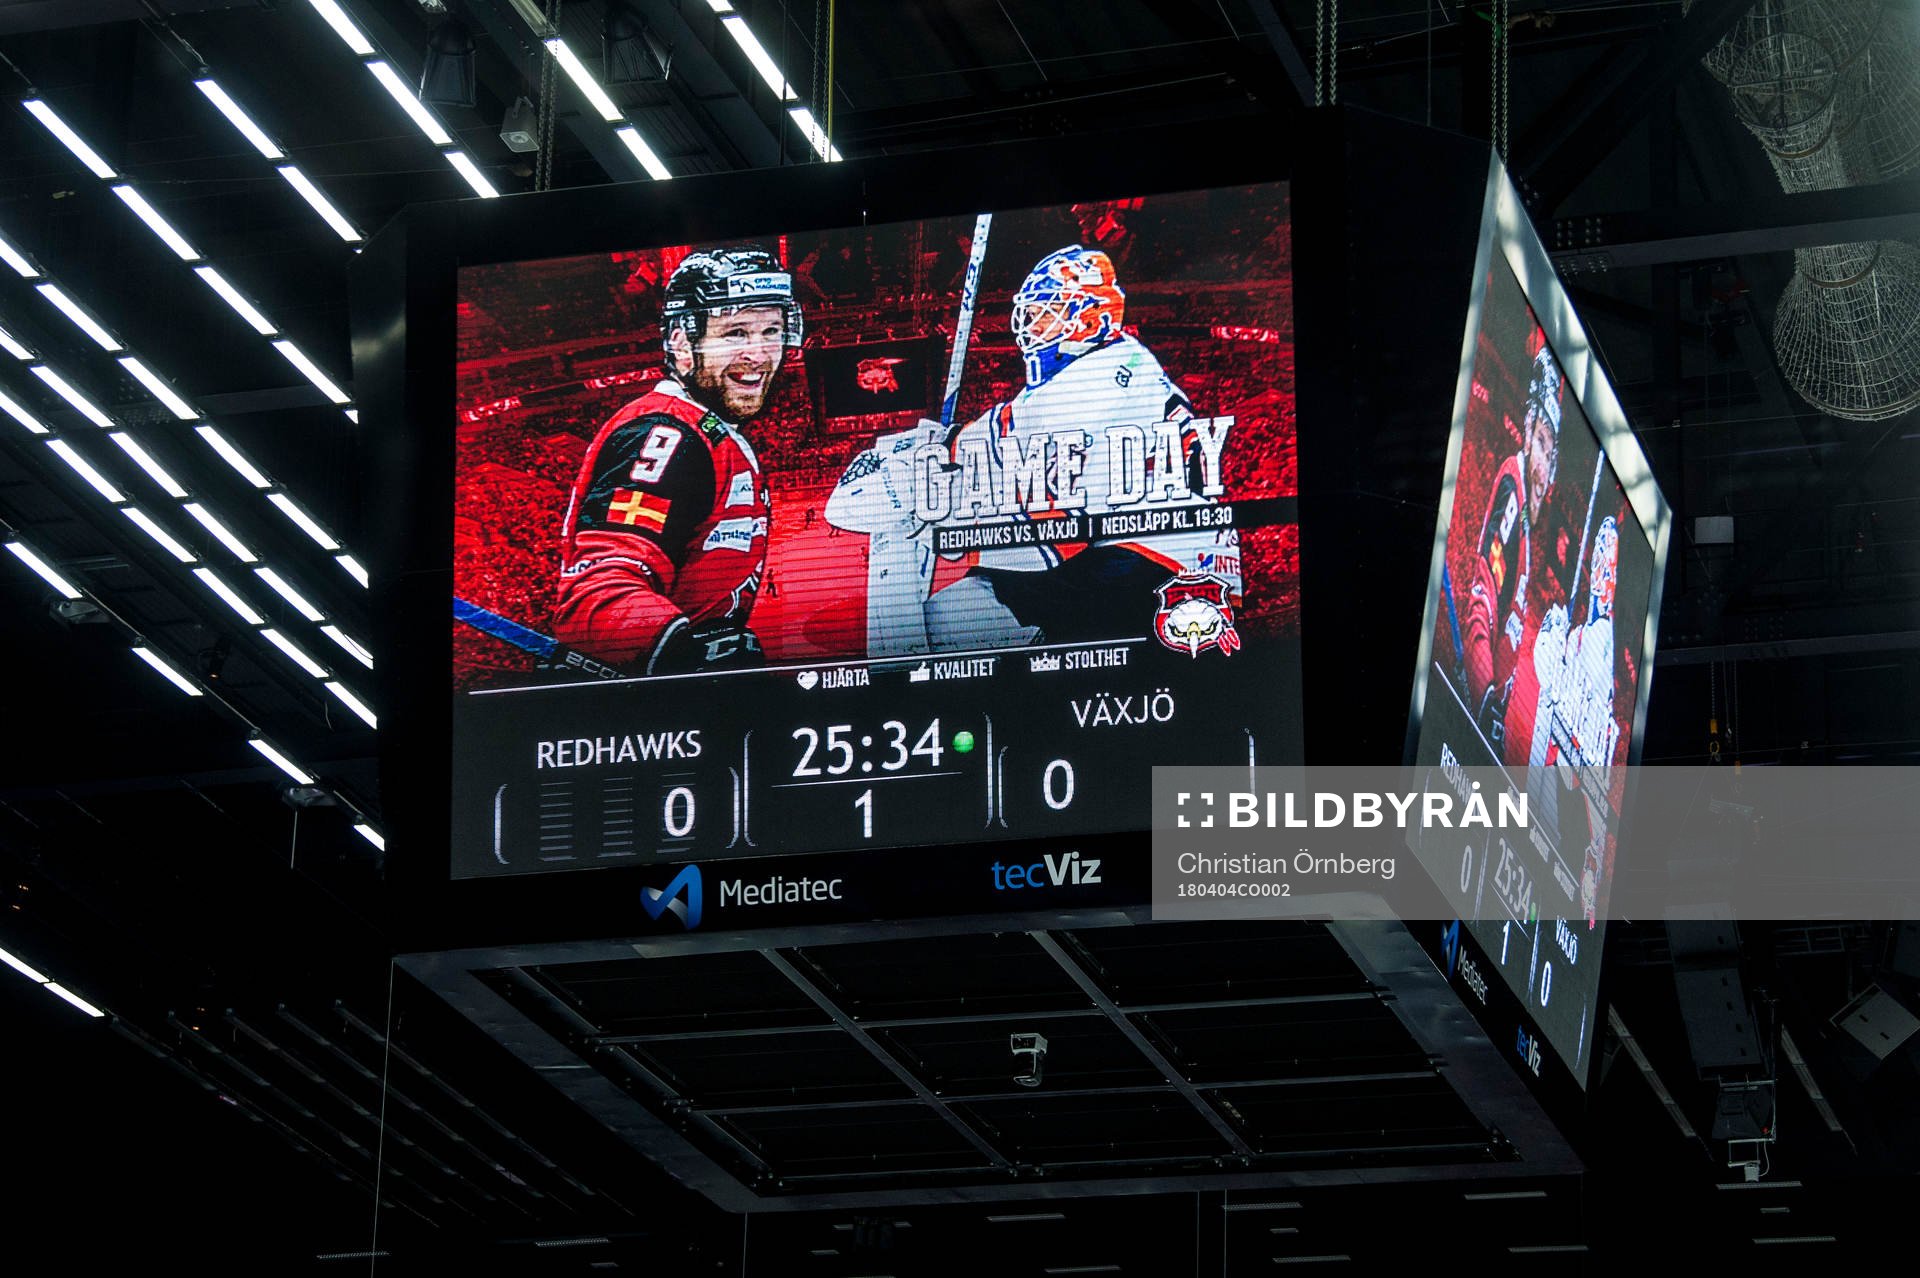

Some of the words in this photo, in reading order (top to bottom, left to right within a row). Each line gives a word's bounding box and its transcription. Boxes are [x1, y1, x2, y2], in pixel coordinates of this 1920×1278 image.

[630, 425, 682, 484] 9
[913, 428, 1088, 522] GAME
[1105, 415, 1235, 506] DAY
[939, 526, 1011, 550] REDHAWKS
[1014, 526, 1035, 543] VS.
[1036, 519, 1079, 540] VÄXJÖ
[1102, 510, 1170, 535] NEDSLÄPP
[822, 668, 870, 689] HJÄRTA
[934, 658, 996, 680] KVALITET
[1065, 647, 1129, 670] STOLTHET
[1071, 687, 1175, 728] VÄXJÖ
[537, 729, 702, 769] REDHAWKS
[792, 718, 944, 777] 25:34
[1043, 759, 1075, 810] 0
[664, 787, 696, 837] 0
[854, 788, 873, 838] 1
[719, 876, 843, 907] Mediatec
[991, 851, 1102, 889] tecViz
[1460, 845, 1472, 893] 0
[1494, 837, 1532, 924] 25:34
[1501, 920, 1511, 966] 1
[1457, 944, 1489, 1007] Mediatec
[1540, 960, 1552, 1007] 0
[1516, 1024, 1541, 1078] tecViz
